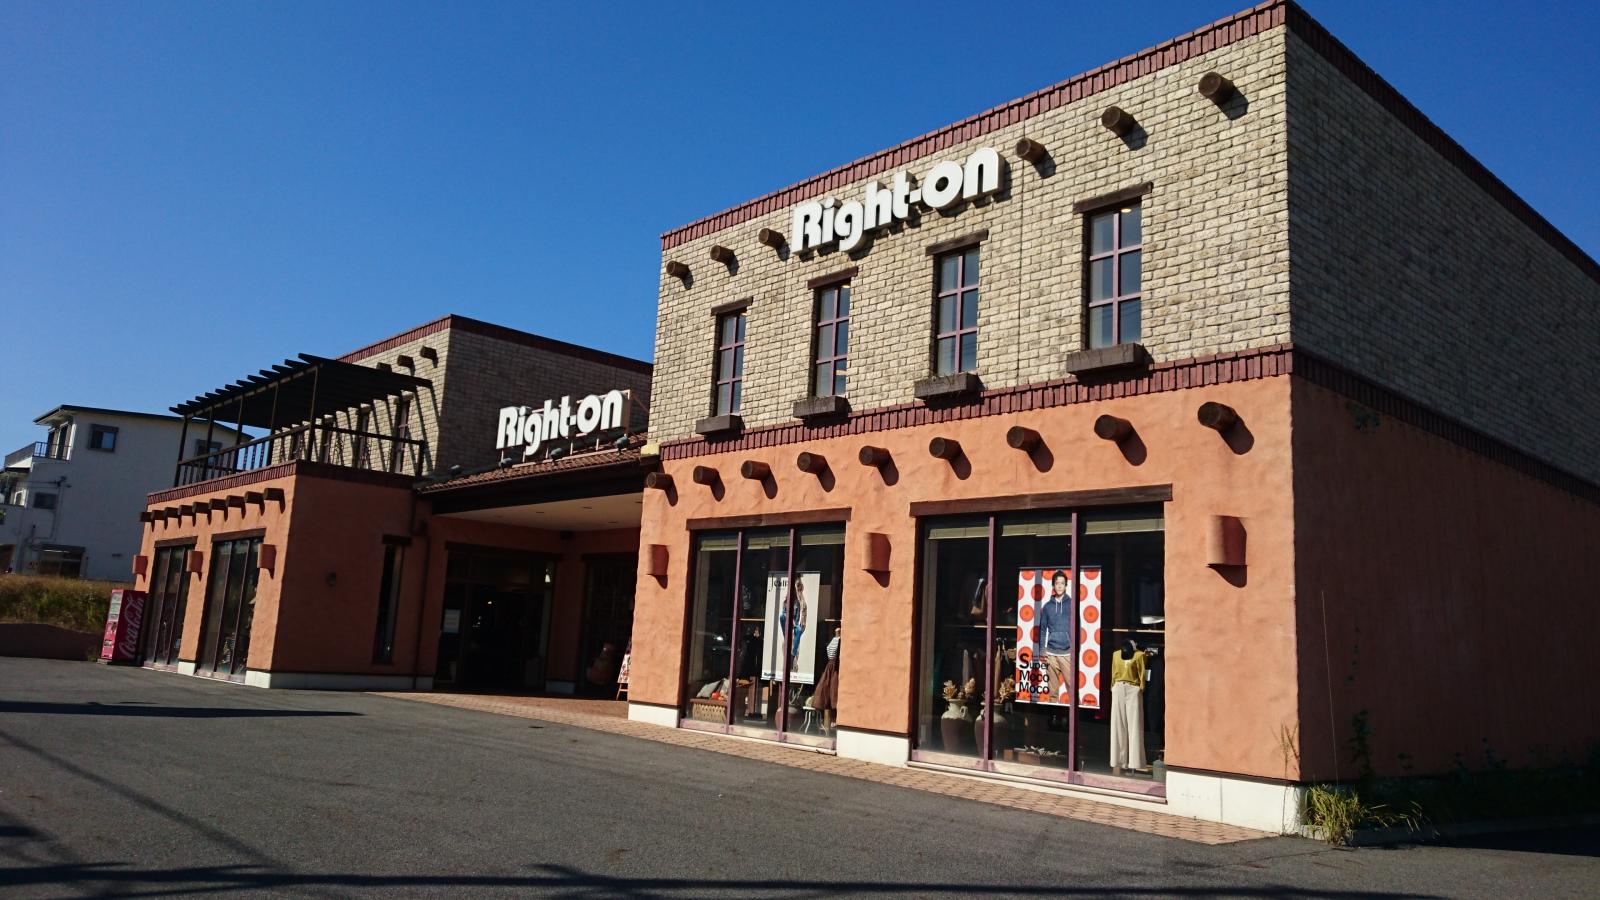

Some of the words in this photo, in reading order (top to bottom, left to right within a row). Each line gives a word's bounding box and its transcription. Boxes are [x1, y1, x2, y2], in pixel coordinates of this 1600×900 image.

[1019, 653, 1050, 670] Super
[1020, 670, 1050, 683] Moco
[1020, 682, 1050, 695] Moco
